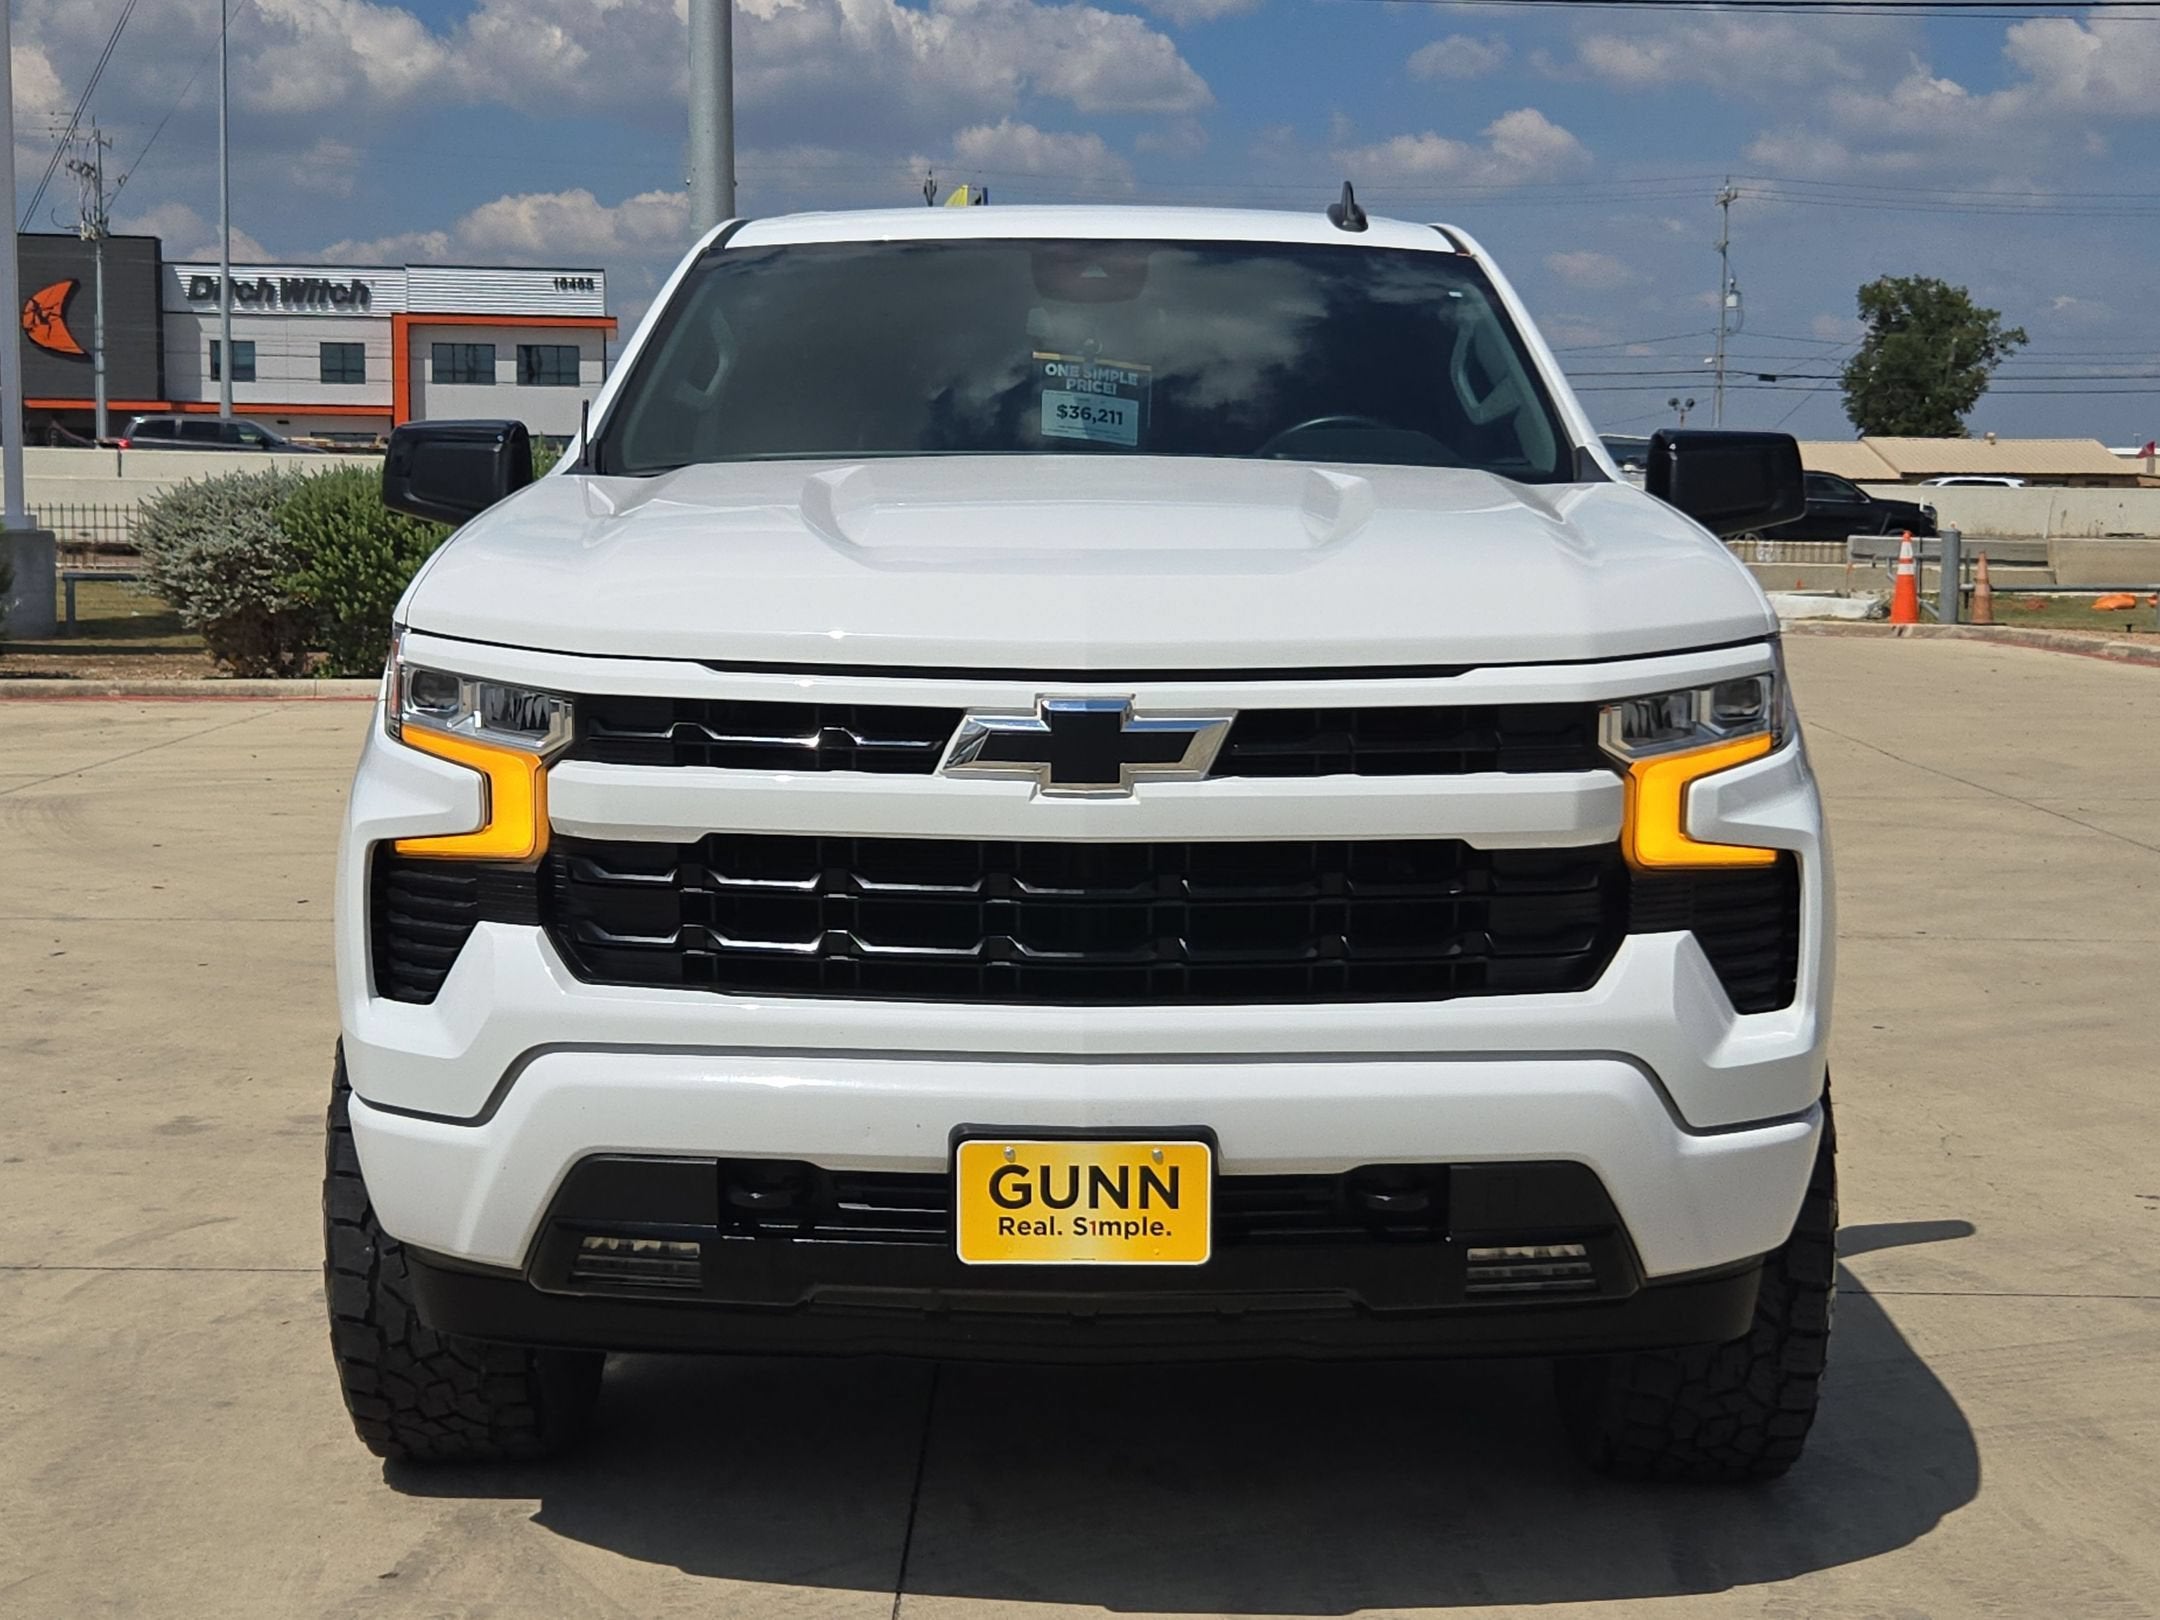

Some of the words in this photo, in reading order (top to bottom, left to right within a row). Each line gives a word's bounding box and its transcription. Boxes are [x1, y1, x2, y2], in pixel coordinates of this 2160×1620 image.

[279, 277, 372, 304] Witch
[1044, 362, 1080, 378] ONE
[1082, 366, 1139, 387] SIMPLE
[1065, 377, 1118, 396] PRICE!
[1055, 403, 1124, 426] $36,211
[988, 1163, 1180, 1210] GUNN
[998, 1216, 1064, 1237] Real.
